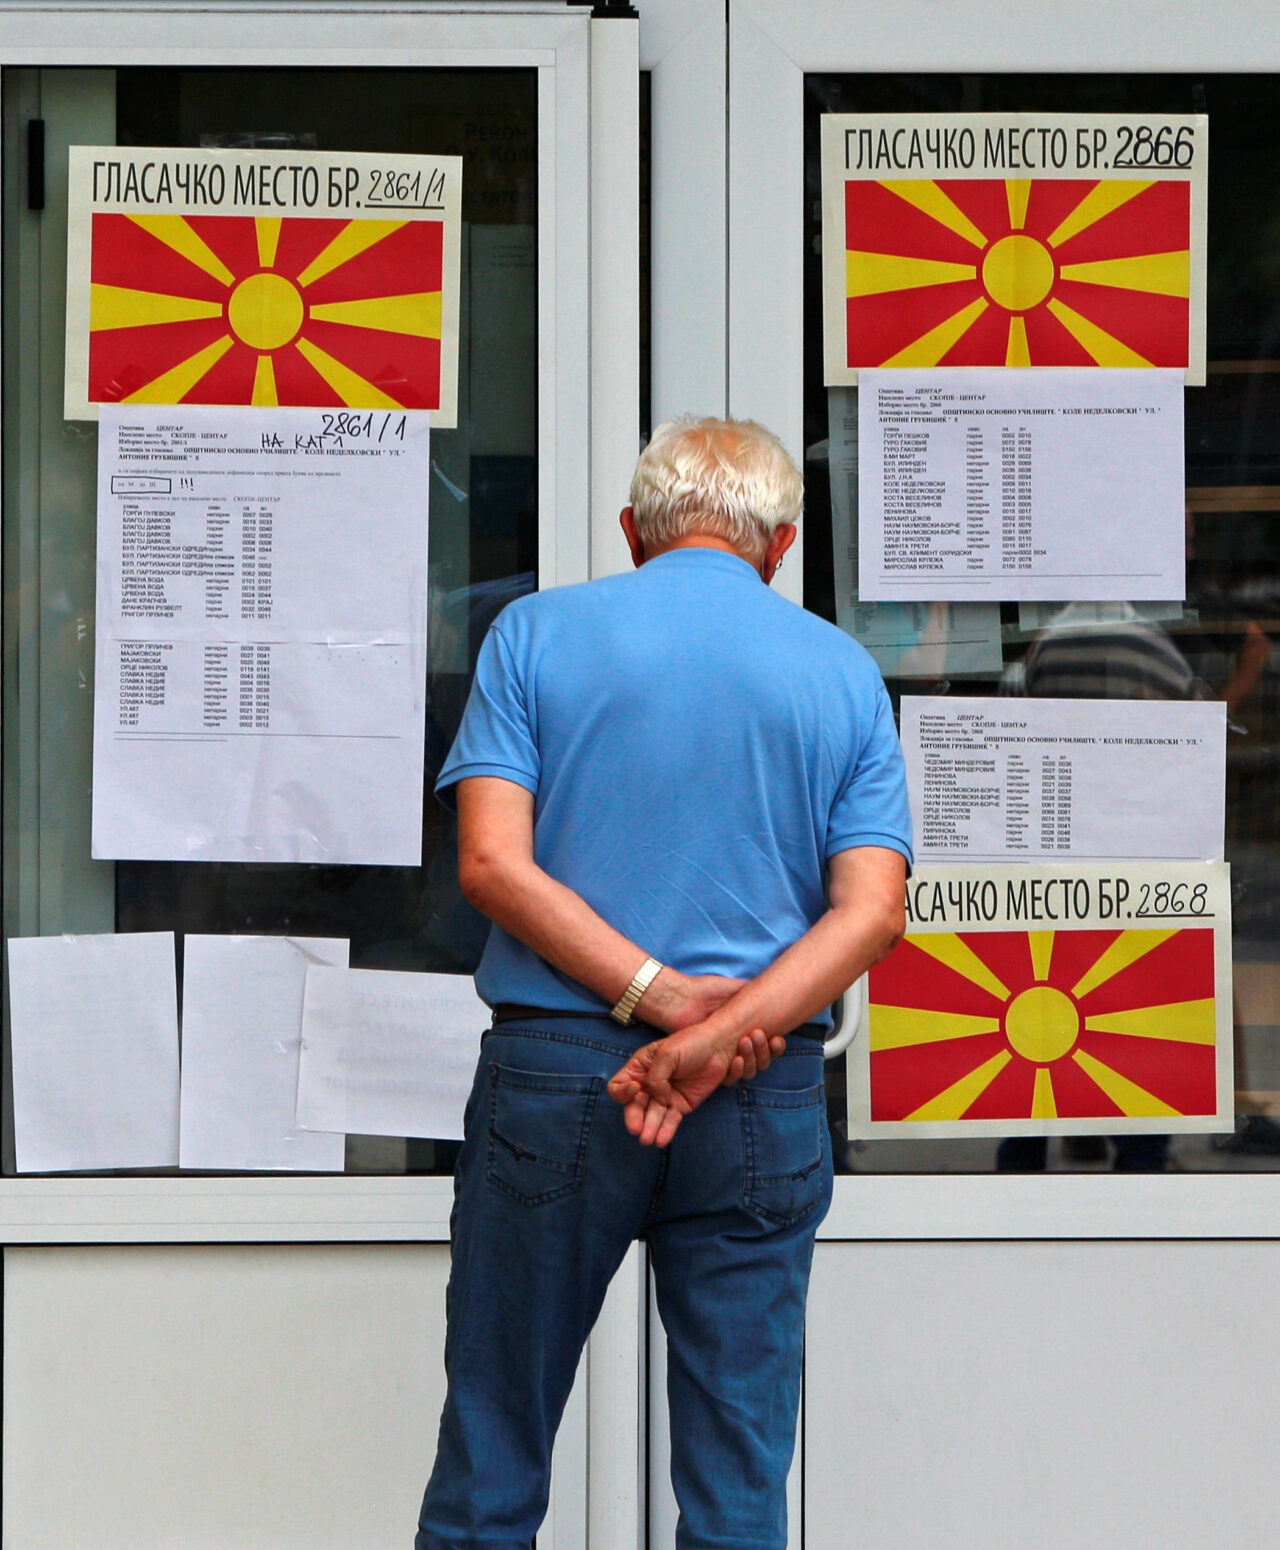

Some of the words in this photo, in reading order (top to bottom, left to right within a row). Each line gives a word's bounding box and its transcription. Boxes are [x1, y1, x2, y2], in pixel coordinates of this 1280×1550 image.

[845, 128, 975, 169] ГЛАСАЧКО
[984, 128, 1067, 168] МЕСТО
[1076, 129, 1109, 169] БР.
[1113, 126, 1194, 168] 2866
[93, 162, 225, 205] ГЛАСАЧКО
[234, 165, 319, 207] МЕСТО
[328, 167, 361, 208] БР.
[369, 167, 445, 208] 2861/1
[262, 432, 284, 448] НА
[295, 434, 327, 450] КАТ
[320, 412, 406, 444] 2861/1
[904, 879, 998, 922] АСАЧКО
[1006, 879, 1090, 920] МЕСТО
[1099, 879, 1132, 919] БР.
[1138, 882, 1208, 915] 2868
